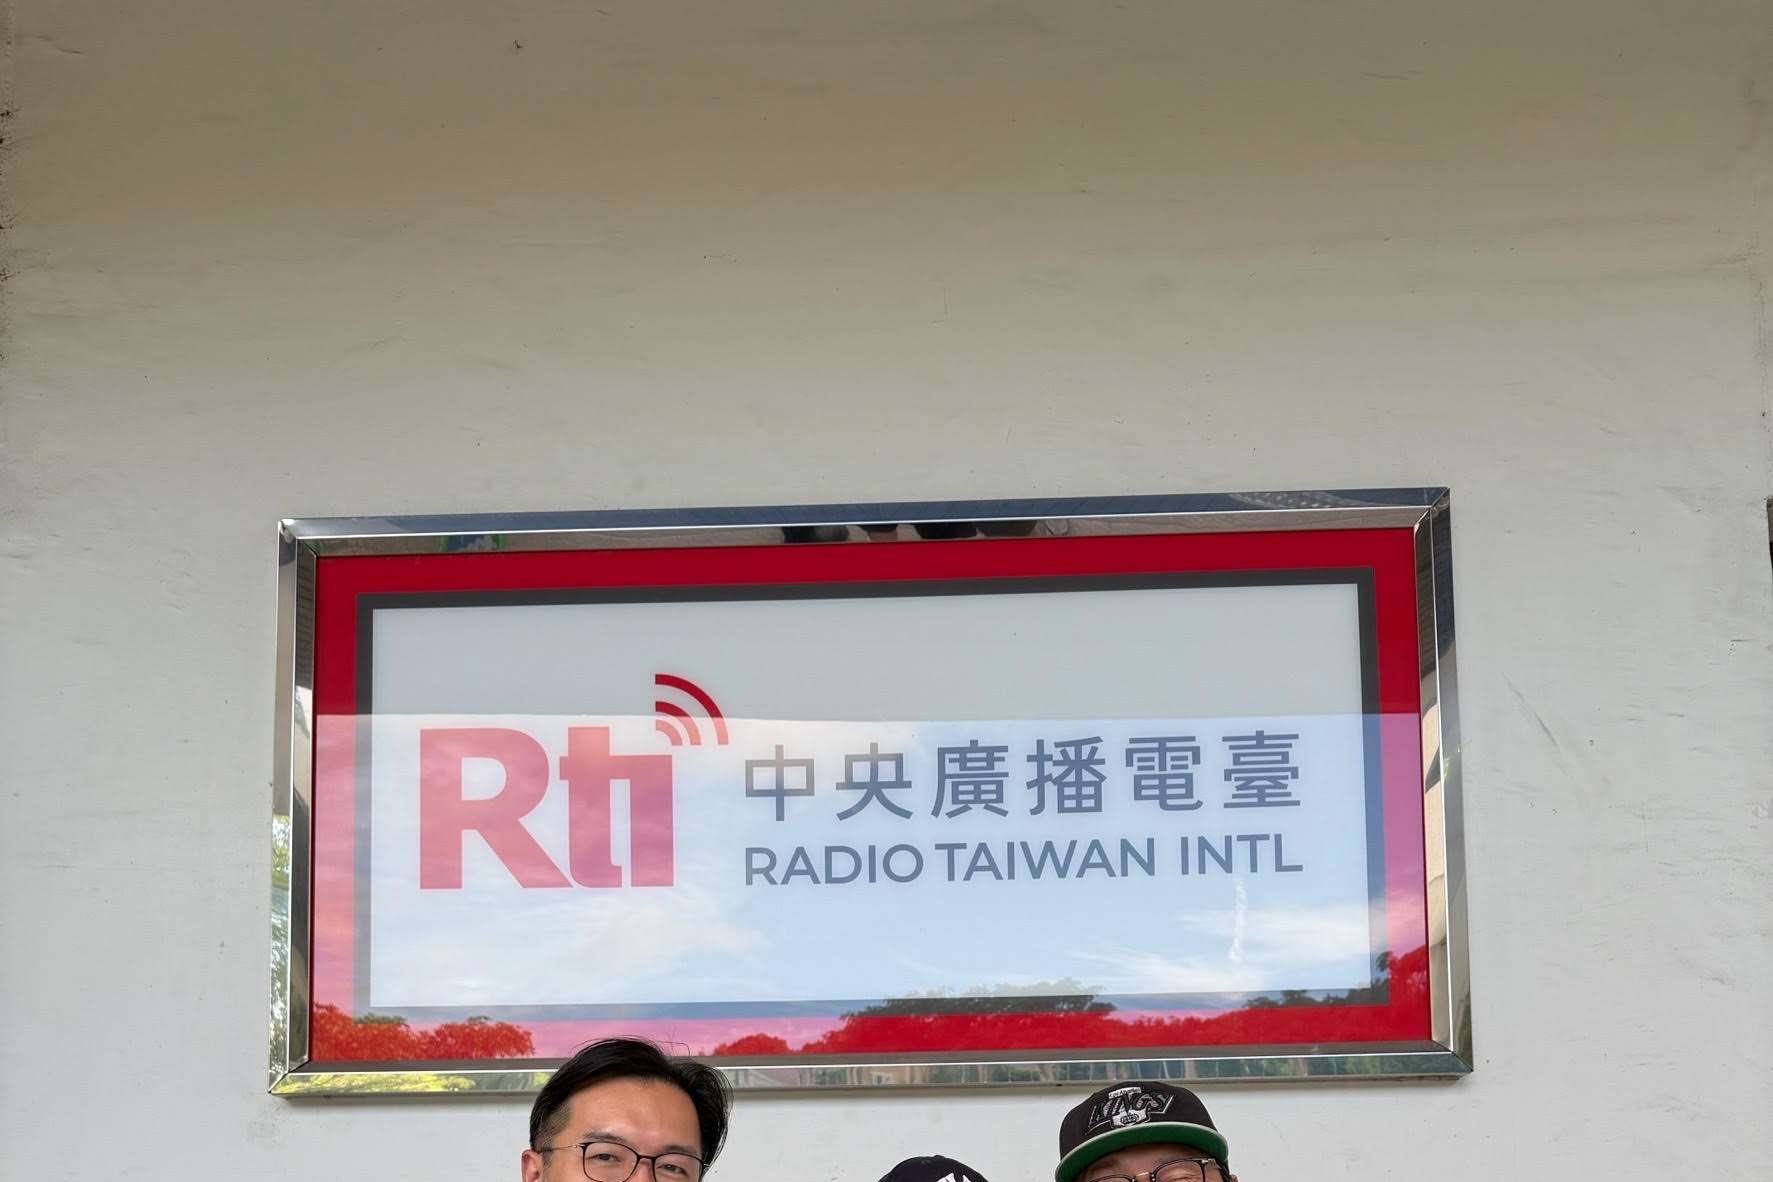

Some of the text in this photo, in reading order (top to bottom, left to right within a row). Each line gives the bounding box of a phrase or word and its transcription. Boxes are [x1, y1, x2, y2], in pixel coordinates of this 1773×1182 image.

[420, 727, 674, 889] Rti
[745, 730, 1301, 822] 中央廣播電臺
[745, 833, 1304, 886] RADIO TAIWAN INTL
